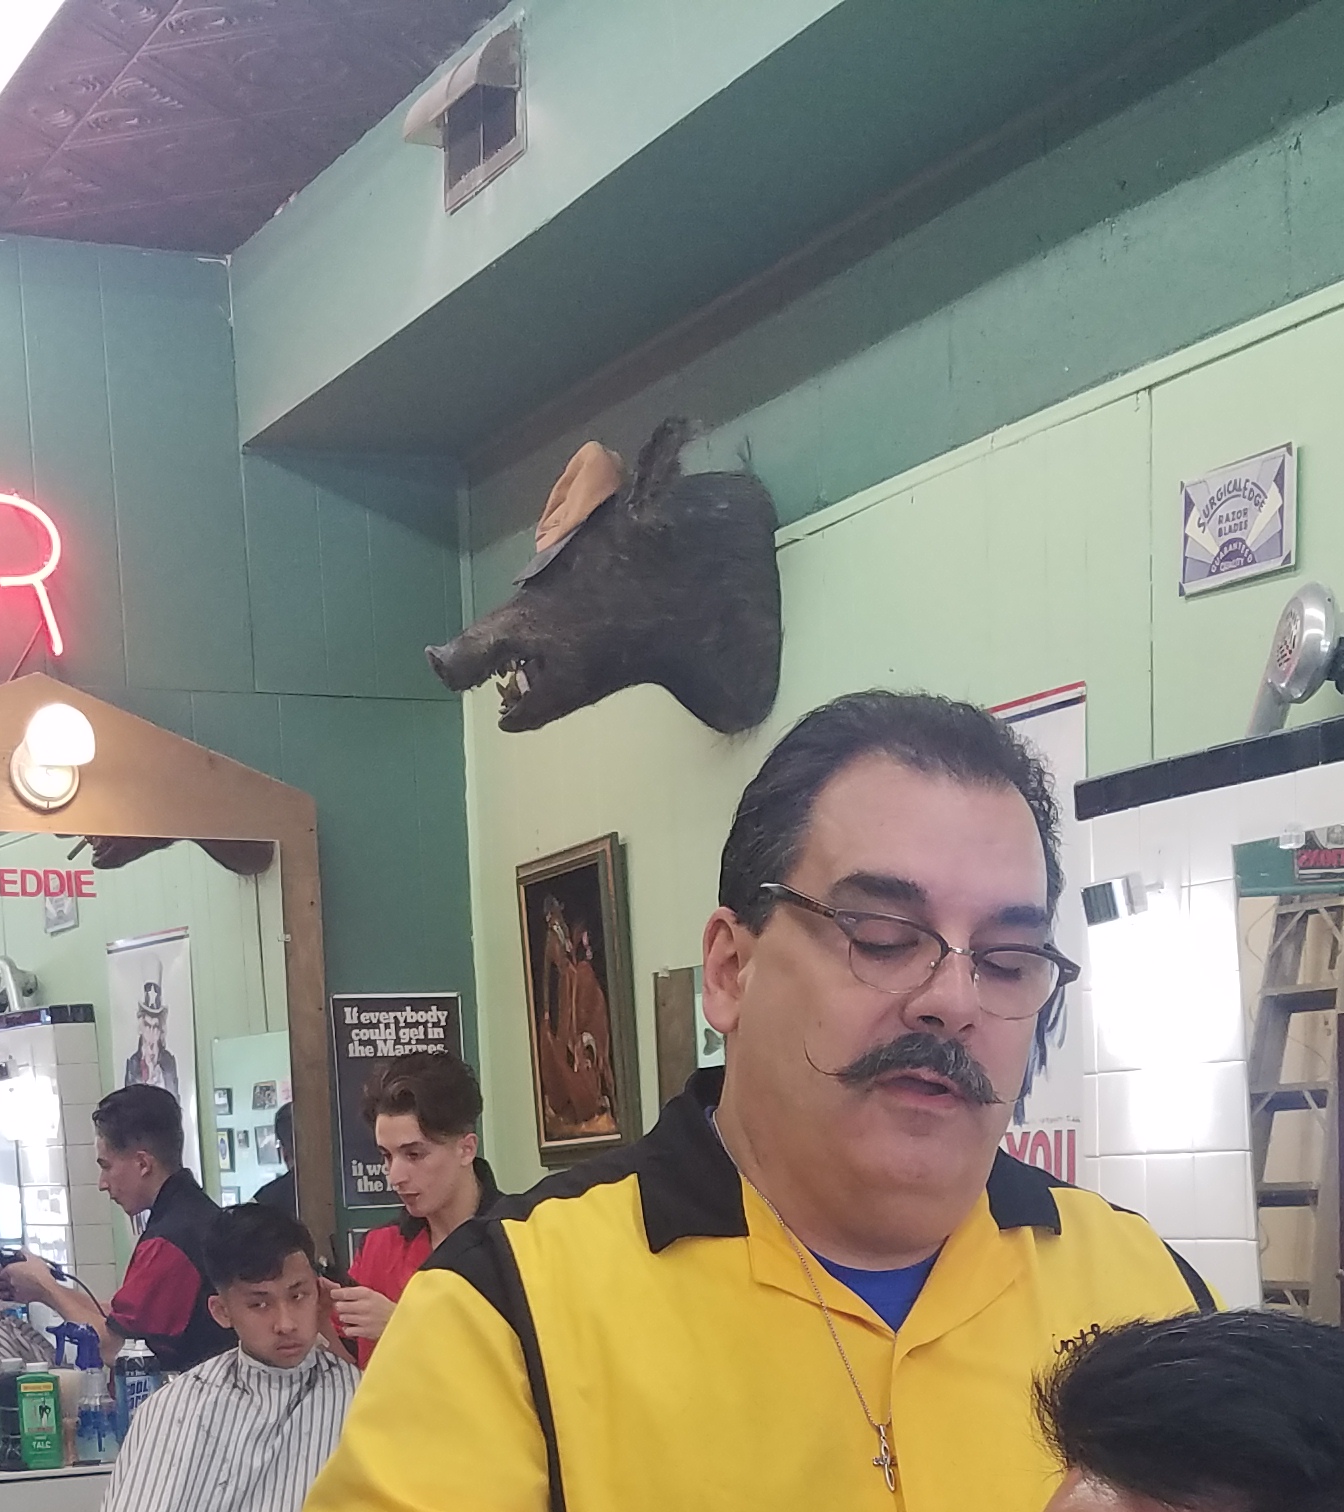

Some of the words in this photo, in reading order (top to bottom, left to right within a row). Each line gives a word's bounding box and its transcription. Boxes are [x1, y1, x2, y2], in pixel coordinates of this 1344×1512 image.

[1197, 477, 1243, 534] SURGICAL
[1242, 478, 1267, 513] EDGE
[1218, 508, 1248, 525] RAZOR
[1218, 520, 1248, 537] BLADES
[344, 1006, 359, 1023] If
[360, 1006, 448, 1026] everybody
[351, 1023, 396, 1040] could
[399, 1025, 425, 1043] get
[427, 1022, 444, 1038] in
[348, 1041, 374, 1057] the
[351, 1159, 364, 1176] it
[357, 1175, 384, 1192] the
